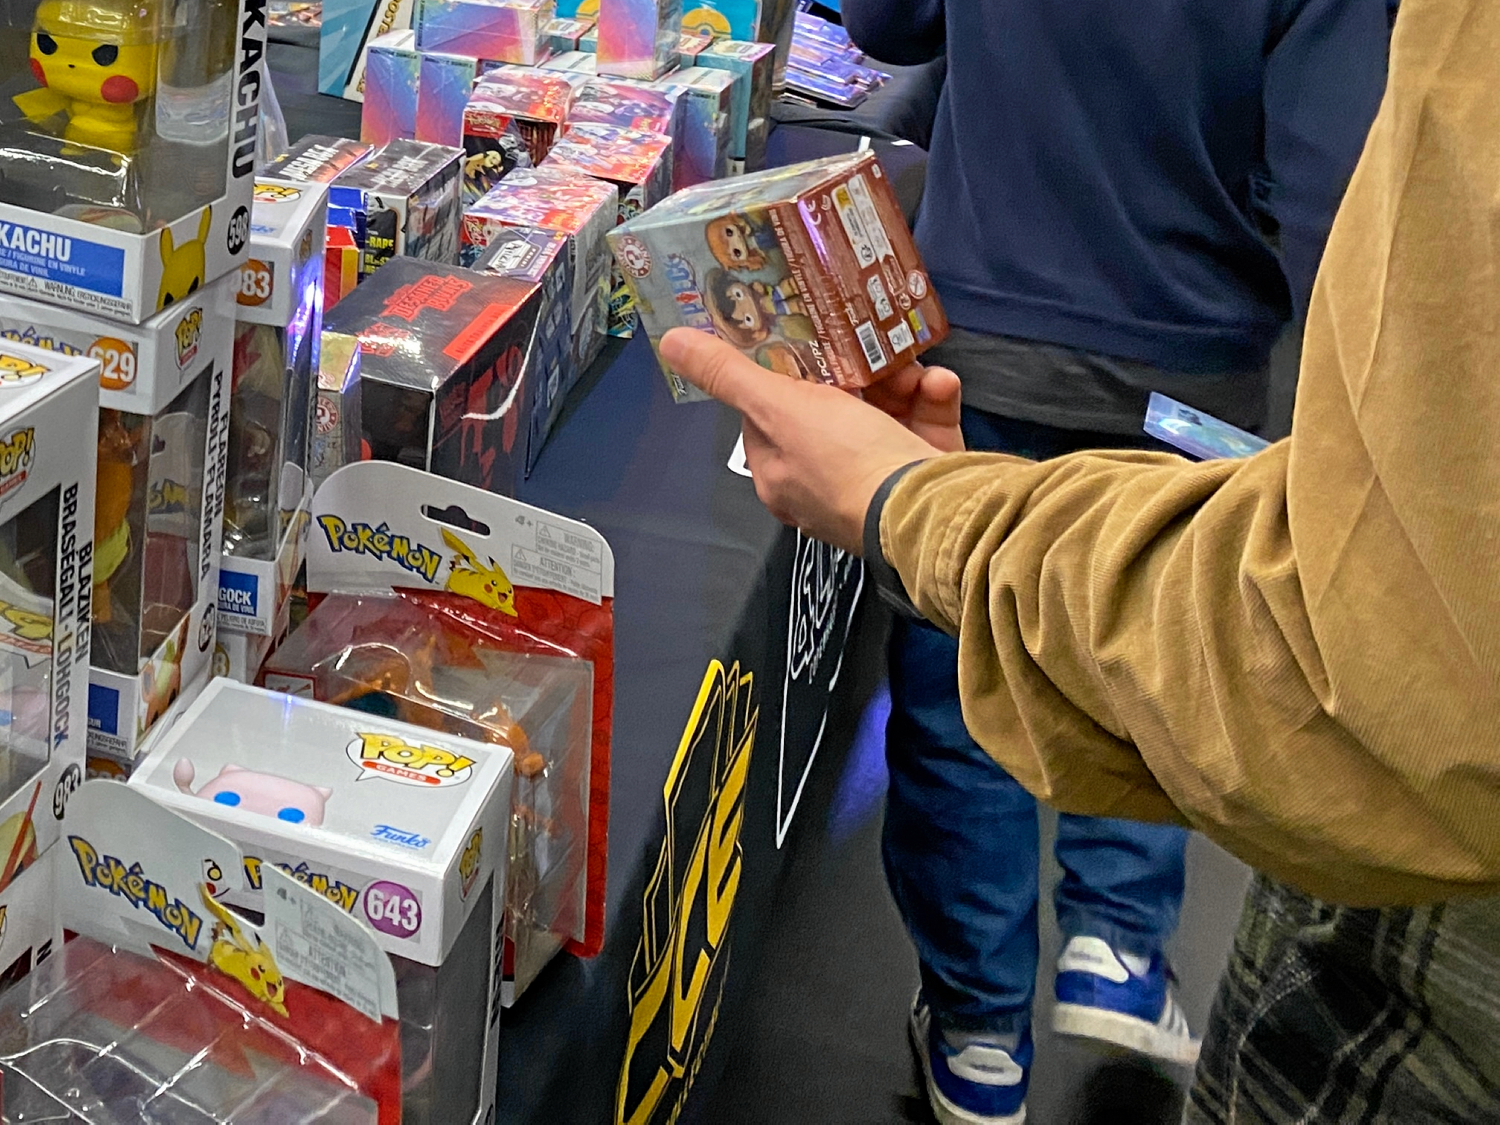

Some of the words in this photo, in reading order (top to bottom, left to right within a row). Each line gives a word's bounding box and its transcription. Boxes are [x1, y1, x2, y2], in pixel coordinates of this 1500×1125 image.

[228, 212, 248, 249] 598
[242, 270, 271, 298] 83
[214, 412, 229, 518] FLAREON
[55, 482, 79, 618] BRASÉGALI
[200, 465, 215, 582] FLAMARA
[317, 515, 441, 583] Pokémon
[74, 541, 95, 665] BLAZIKEN
[54, 637, 73, 751] LOHGOCK
[356, 731, 476, 777] POP!
[376, 763, 429, 783] GAMES
[371, 824, 430, 849] Funko
[68, 834, 204, 949] Pokémon
[365, 889, 419, 932] 643
